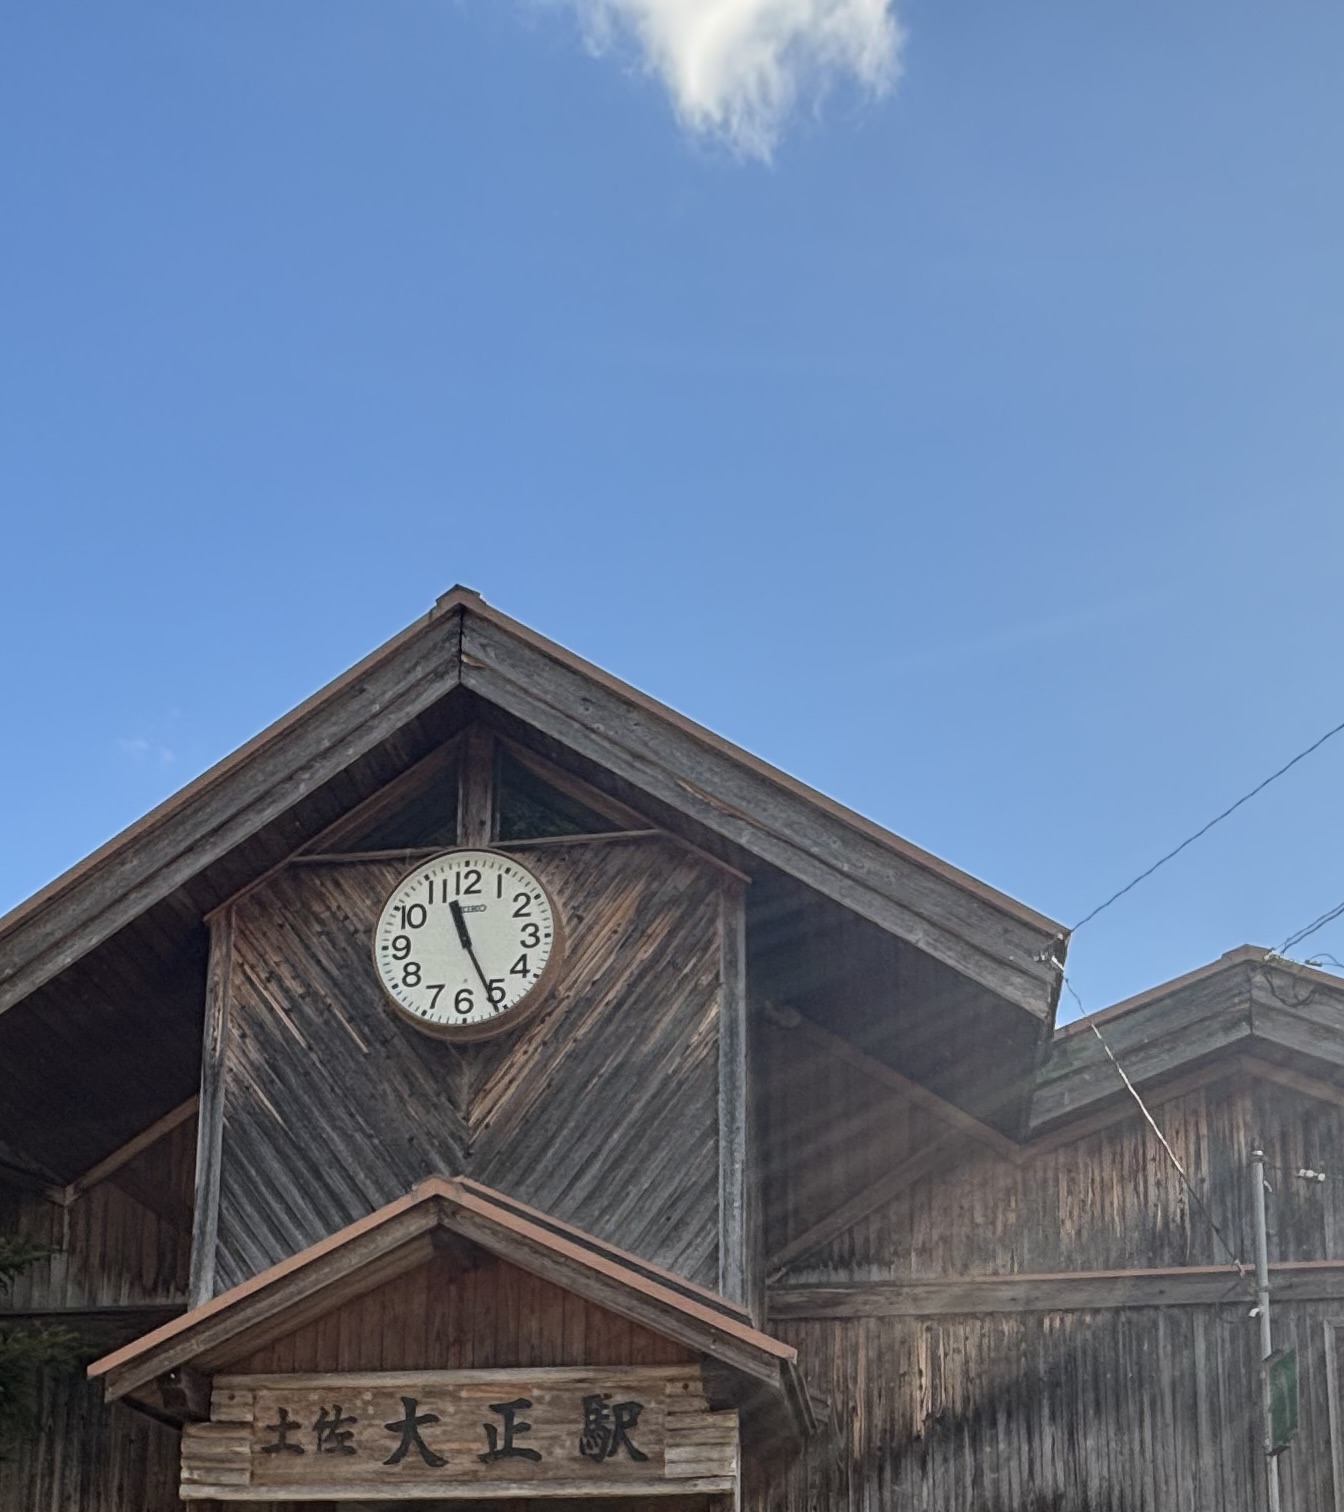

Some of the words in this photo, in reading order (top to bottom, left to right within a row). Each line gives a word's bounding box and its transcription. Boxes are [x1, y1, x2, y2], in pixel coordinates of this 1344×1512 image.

[428, 879, 447, 904] 11
[456, 869, 482, 895] 12
[497, 873, 502, 898] 1
[401, 903, 427, 929] 10
[512, 892, 532, 918] 2
[391, 935, 411, 960] 9
[520, 922, 540, 948] 3
[401, 962, 421, 987] 8
[509, 953, 530, 978] 4
[425, 984, 445, 1009] 7
[454, 989, 474, 1014] 6
[488, 978, 506, 1004] 5
[259, 1393, 650, 1469] 土佐大正駅
